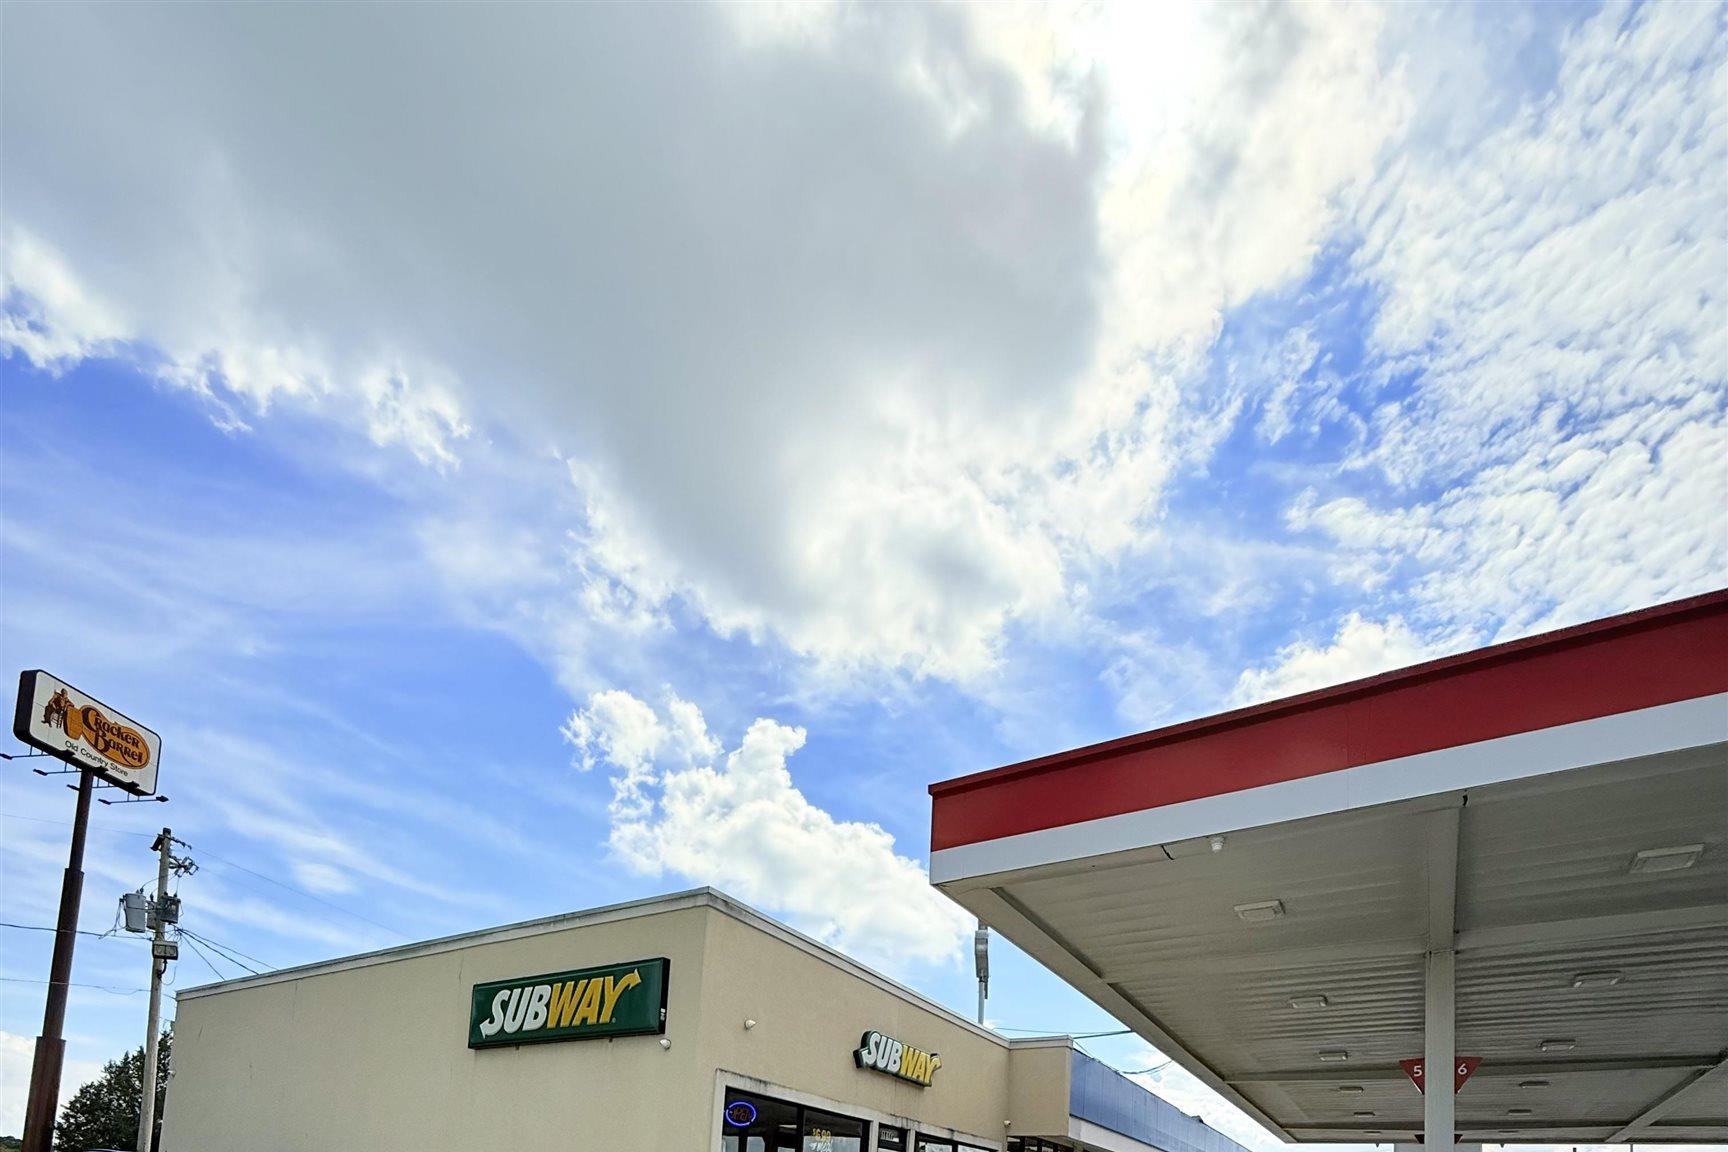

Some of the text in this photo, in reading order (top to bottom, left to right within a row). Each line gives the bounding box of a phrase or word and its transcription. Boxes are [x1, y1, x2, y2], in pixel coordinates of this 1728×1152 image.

[81, 707, 140, 749] Cracker
[93, 728, 144, 762] Barrel
[65, 740, 129, 776] Old Country Store
[479, 968, 642, 1039] SUBWAY
[861, 1032, 942, 1084] SUBWAY
[1413, 1065, 1423, 1077] 5
[1457, 1063, 1468, 1075] 6
